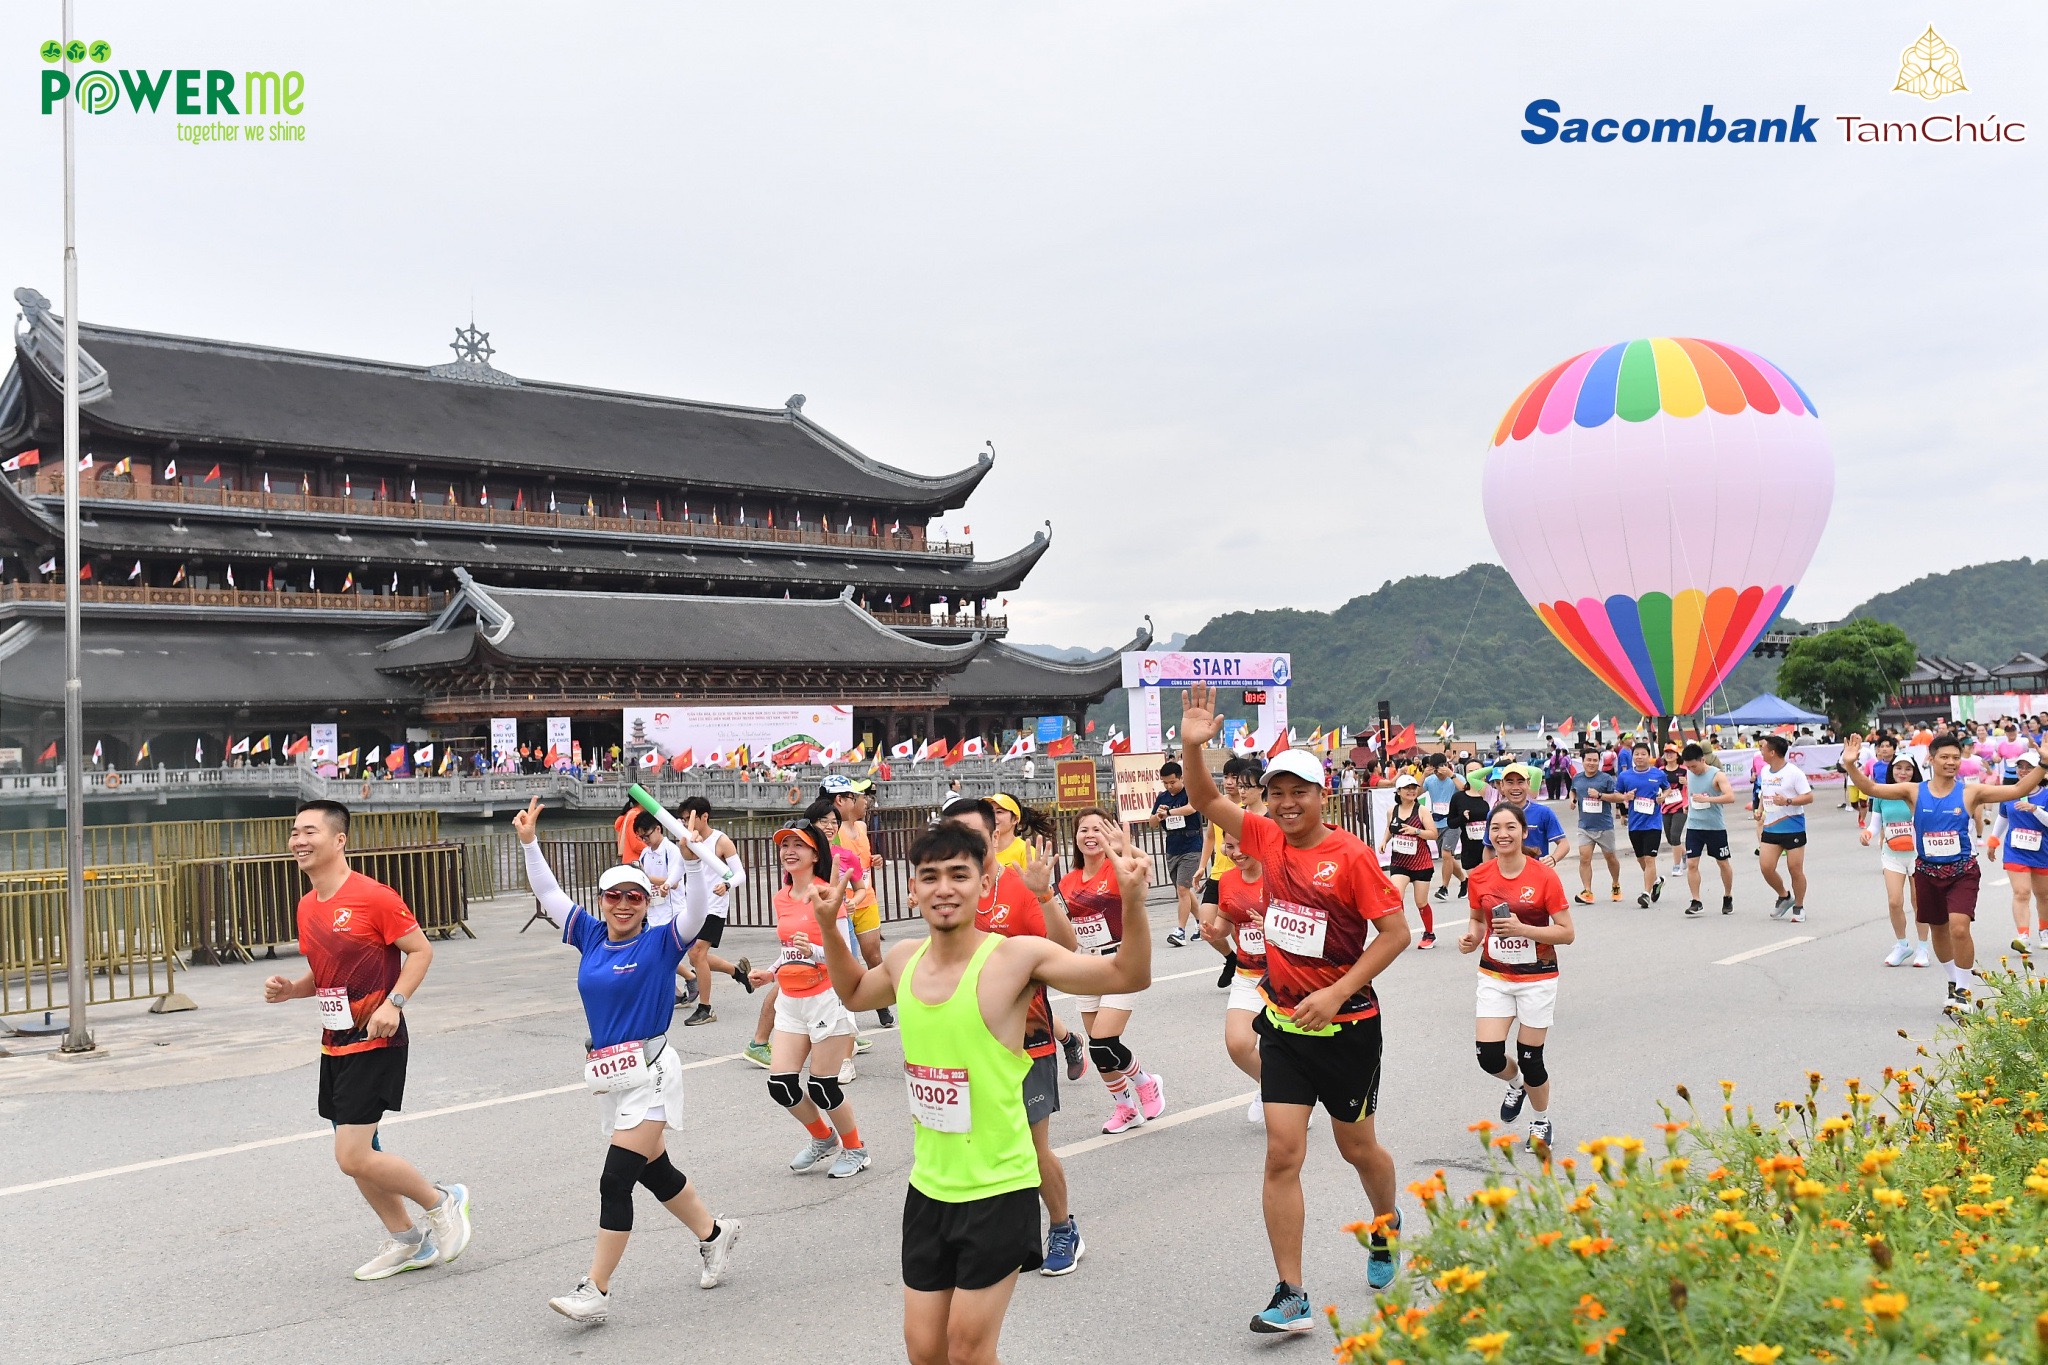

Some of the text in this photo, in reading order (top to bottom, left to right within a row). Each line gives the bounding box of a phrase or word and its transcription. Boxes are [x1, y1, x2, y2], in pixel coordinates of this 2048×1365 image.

[1193, 658, 1241, 676] START
[1119, 787, 1145, 811] MIỄN
[1890, 827, 1912, 835] 10661
[1927, 838, 1955, 847] 10828
[1273, 914, 1316, 936] 10031
[1244, 931, 1263, 941] 100
[1494, 939, 1530, 950] 10034
[592, 1055, 638, 1078] 10128
[909, 1081, 959, 1105] 10302
